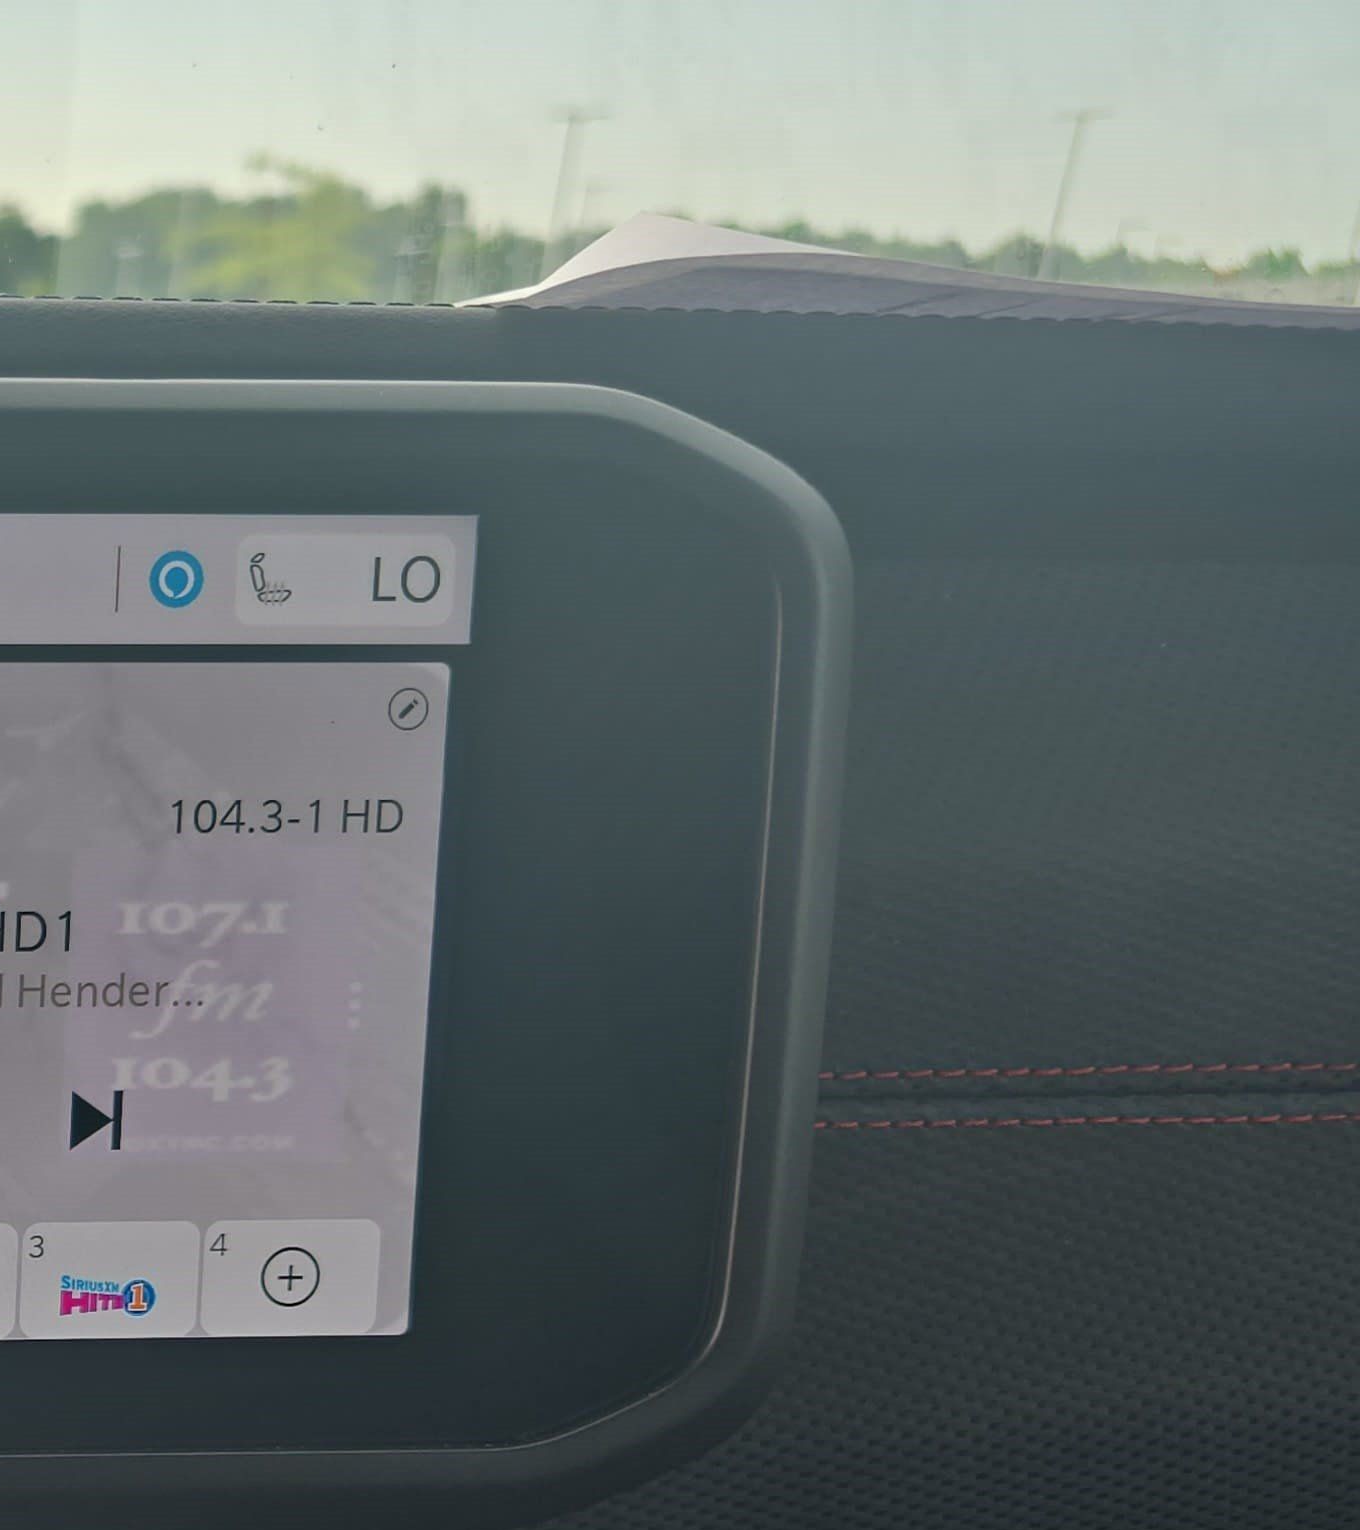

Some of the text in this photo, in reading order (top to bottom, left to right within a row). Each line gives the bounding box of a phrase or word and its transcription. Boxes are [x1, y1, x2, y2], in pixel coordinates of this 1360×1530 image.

[372, 555, 442, 603] LO
[171, 798, 405, 835] 104.3-1 HD
[114, 902, 289, 949] 107.1
[18, 972, 205, 1010] Hender...
[28, 1235, 46, 1259] 3
[209, 1233, 228, 1257] 4
